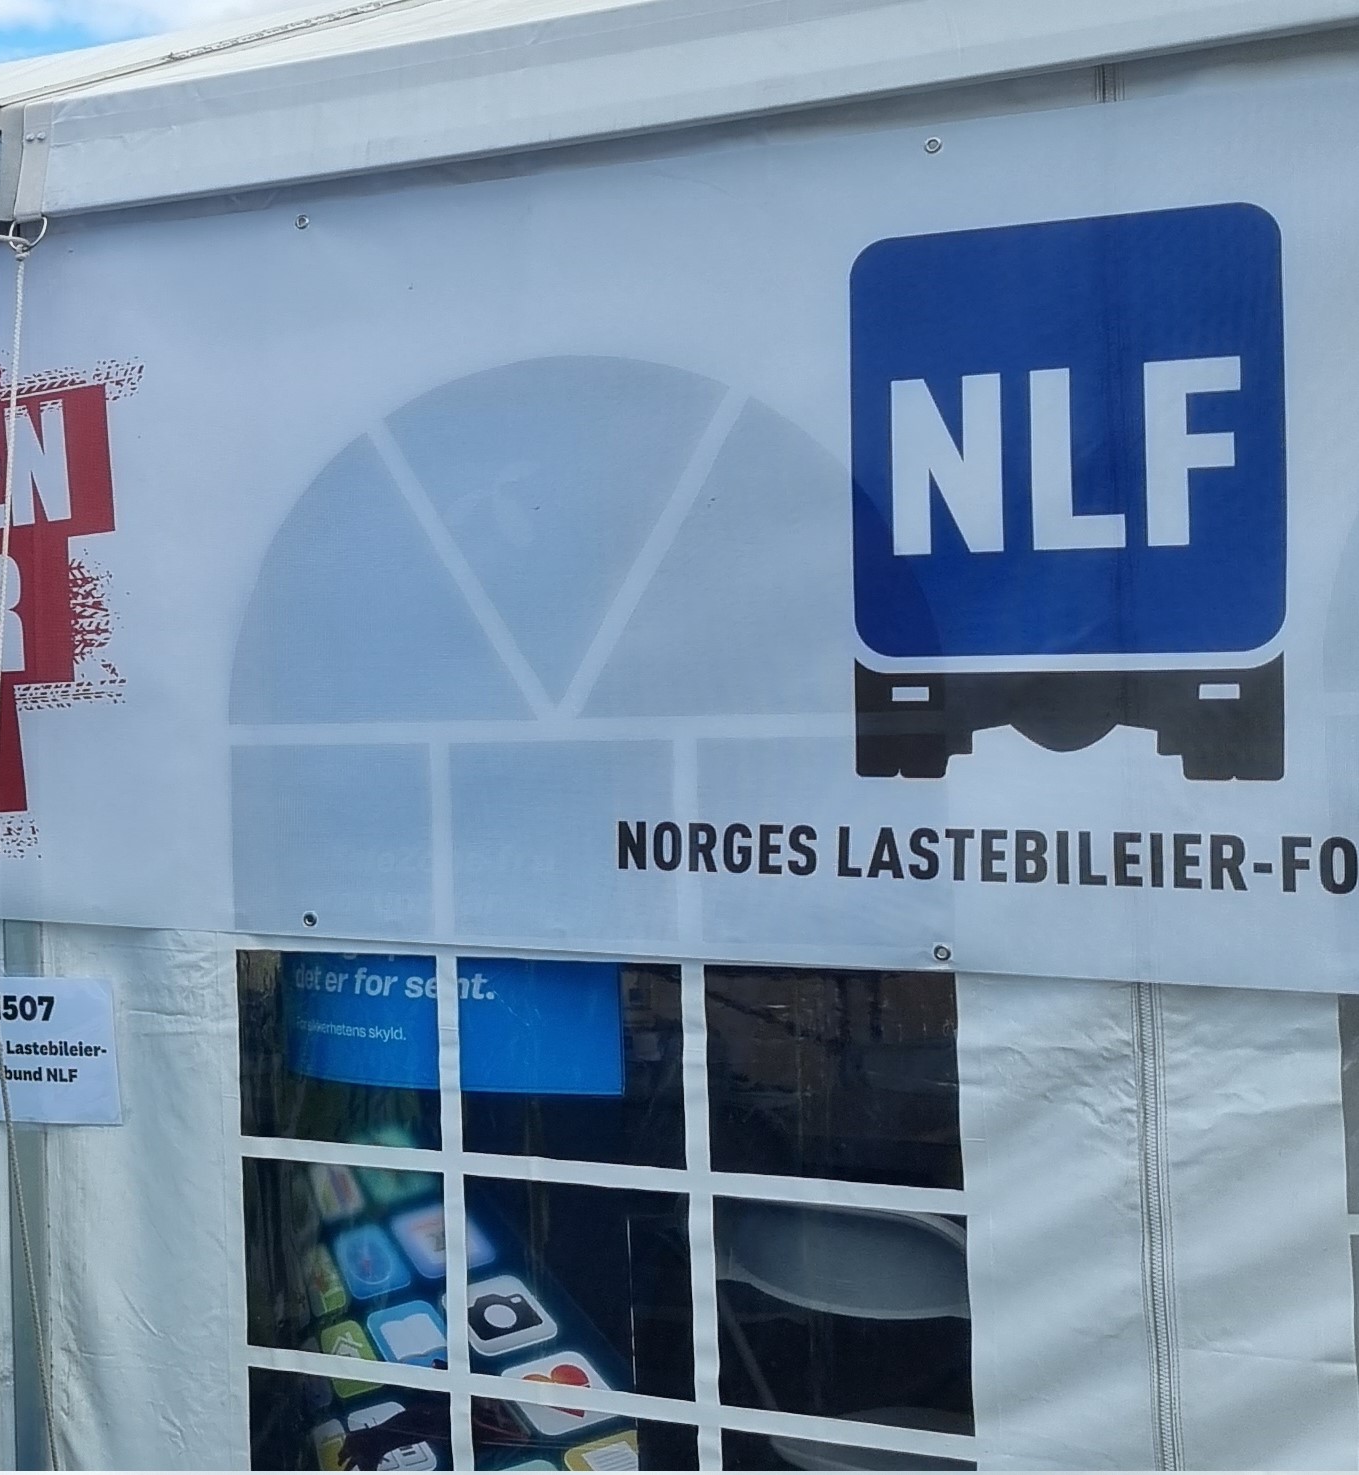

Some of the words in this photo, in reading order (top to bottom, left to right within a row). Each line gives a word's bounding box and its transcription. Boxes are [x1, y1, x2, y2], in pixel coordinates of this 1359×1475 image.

[890, 356, 1241, 556] NLF
[617, 820, 817, 877] NORGES
[837, 825, 1359, 894] LASTEBILEIER-FO
[295, 963, 321, 991] det
[325, 972, 348, 993] er
[354, 967, 398, 997] for
[369, 1026, 407, 1043] skyld.
[6, 1040, 108, 1057] Lastebileier-
[46, 1067, 78, 1083] NLF
